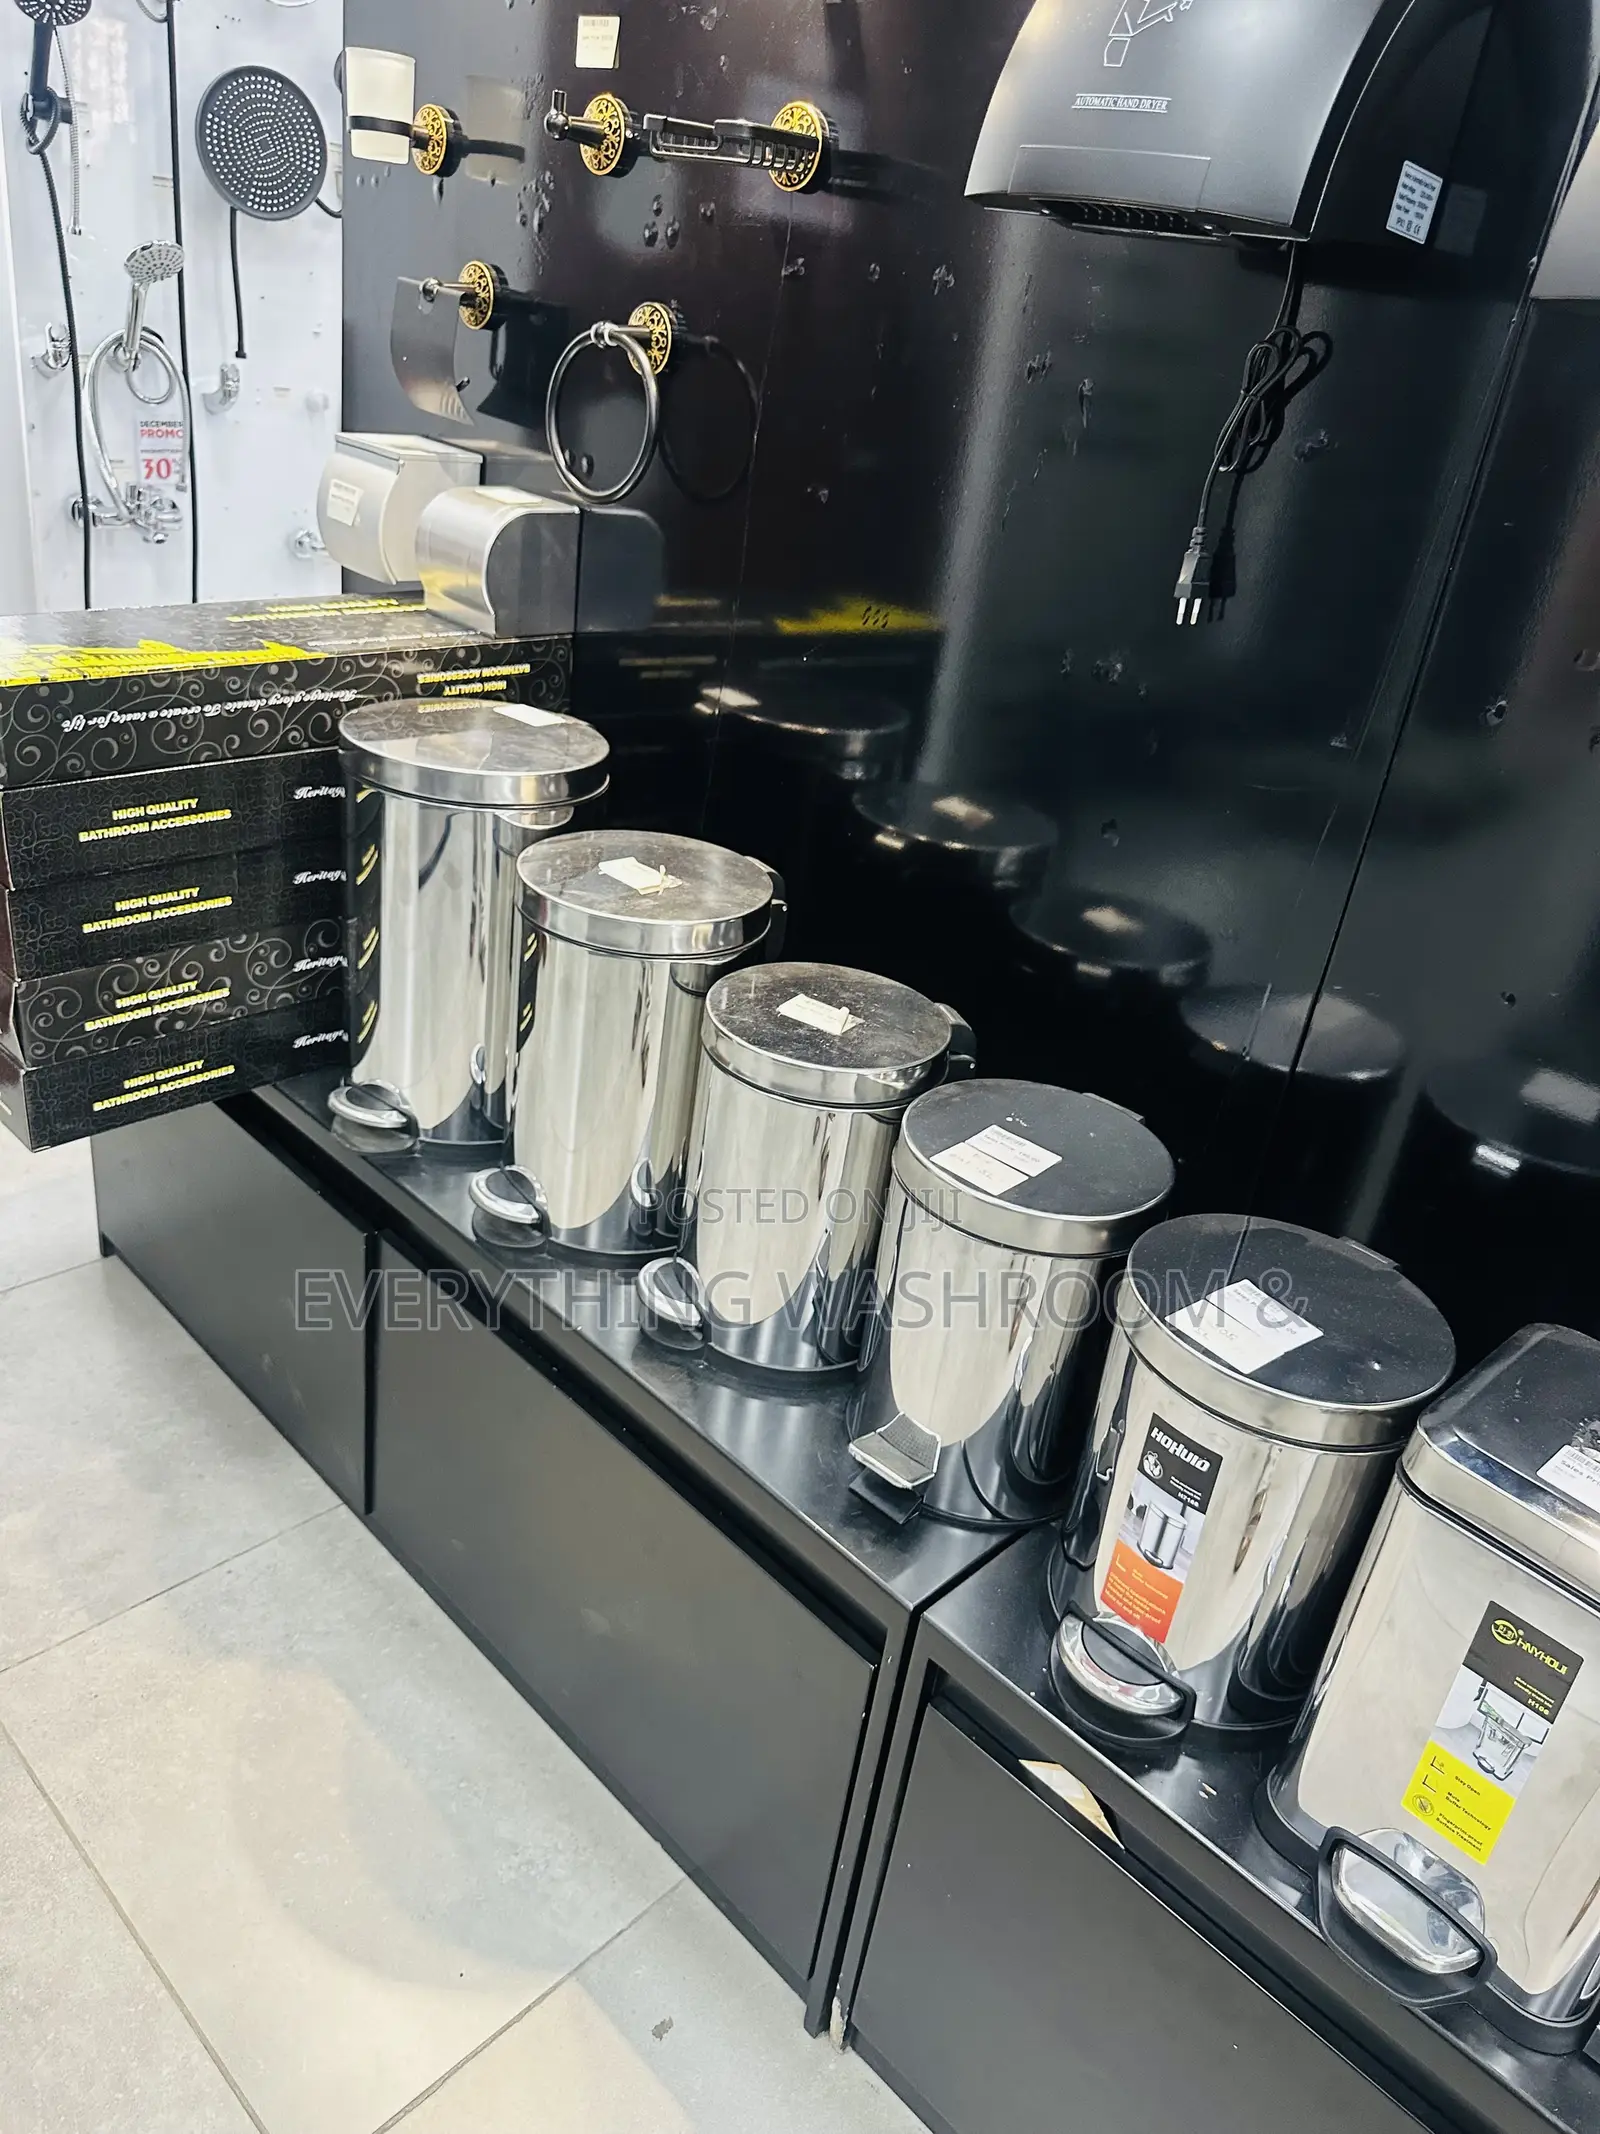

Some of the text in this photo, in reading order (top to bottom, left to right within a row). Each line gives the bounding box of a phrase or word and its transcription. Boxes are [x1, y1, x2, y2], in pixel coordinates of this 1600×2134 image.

[1075, 96, 1168, 110] AUTOMATIC HAND DRYER
[140, 429, 184, 438] PROMO
[416, 664, 531, 684] BATHROOM ACCESSORIES
[443, 680, 507, 696] HIGH QUALITY
[159, 705, 202, 718] create
[294, 786, 344, 800] Heritag
[112, 798, 198, 821] HIGH QUALITY
[78, 808, 232, 842] BATHROOM ACCESSORIES
[292, 870, 343, 884] Heritag
[114, 886, 200, 912] HIGH QUALITY
[82, 896, 232, 934] BATHROOM ACCESSORIES
[116, 980, 198, 1009] HIGH QUALITY
[84, 987, 230, 1032] BATHROOM ACCESSORIES
[124, 1060, 204, 1090] HIGH QUALITY
[93, 1064, 236, 1112] BATHROOM ACCESSORIES
[1560, 1459, 1584, 1476] Sales
[1466, 1784, 1481, 1796] Open
[1462, 1808, 1492, 1831] Technology
